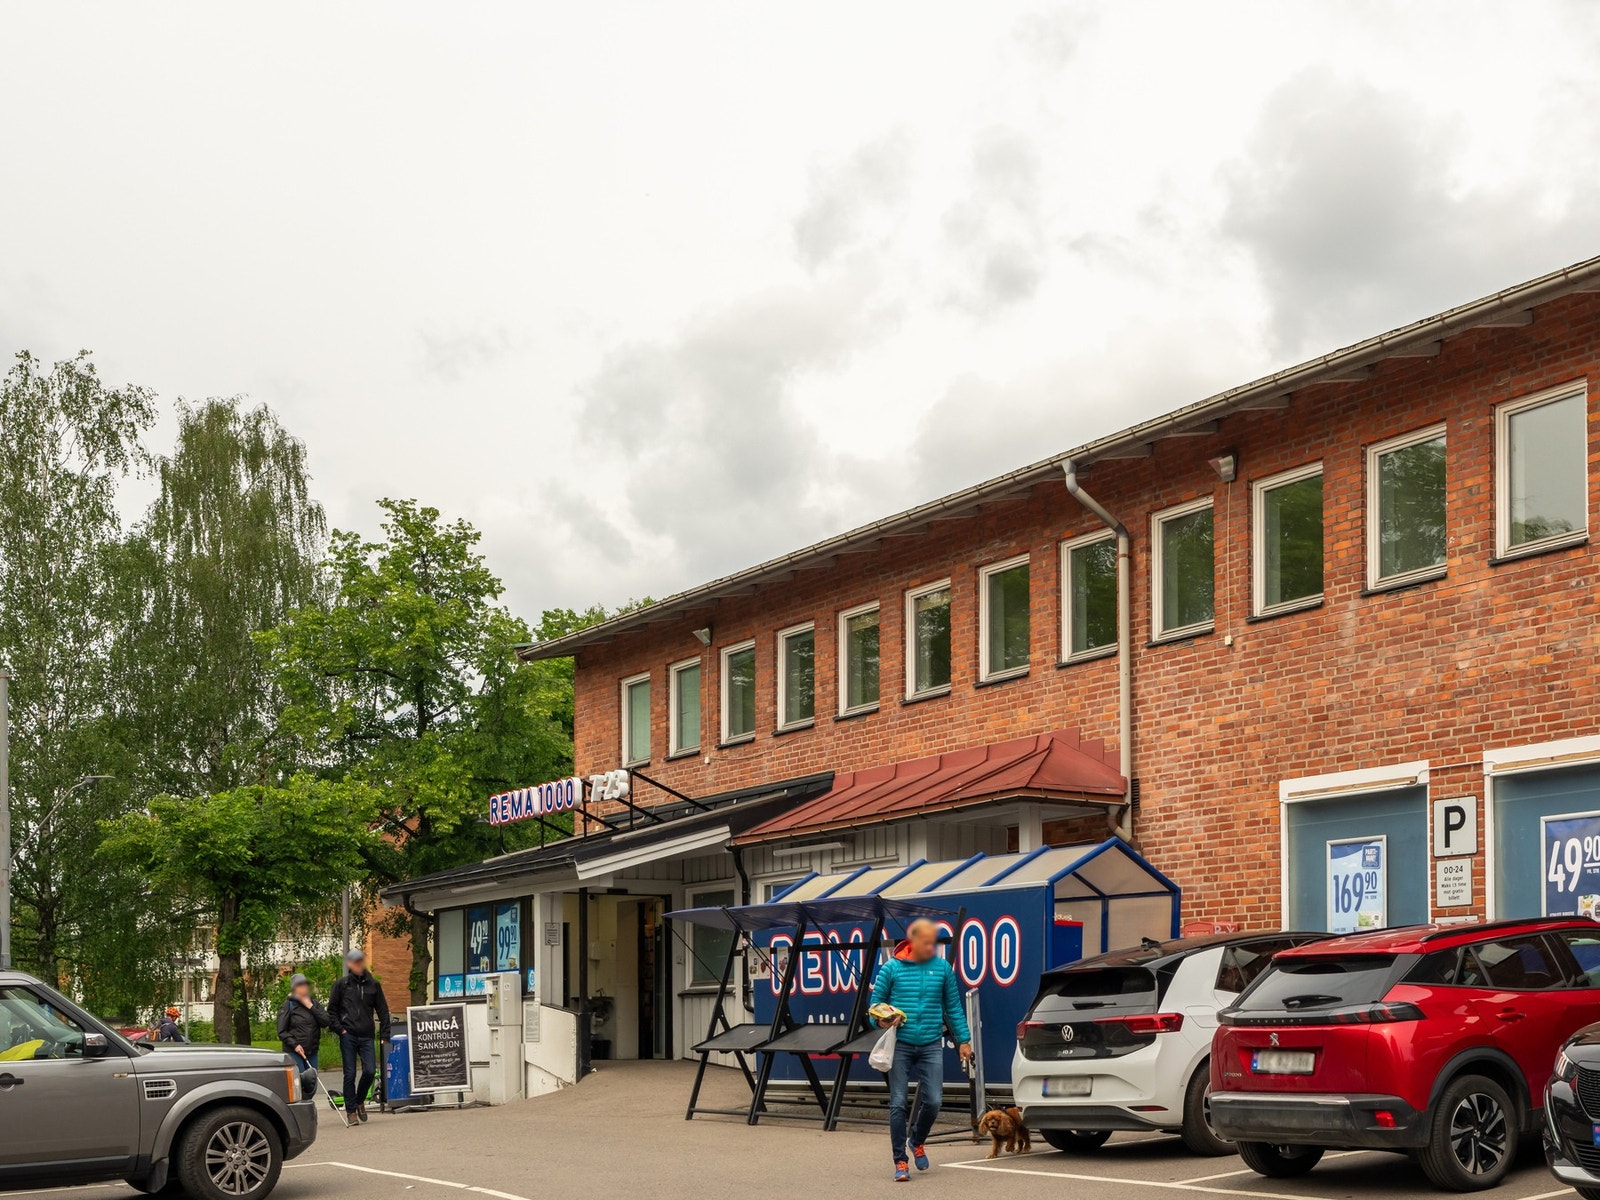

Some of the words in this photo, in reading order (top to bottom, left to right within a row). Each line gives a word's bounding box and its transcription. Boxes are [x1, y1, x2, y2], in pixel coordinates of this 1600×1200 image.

[489, 787, 535, 825] REMA
[537, 777, 577, 815] 1000
[589, 769, 628, 802] 7-23
[1444, 805, 1466, 848] P
[1444, 865, 1463, 874] 00-24
[1548, 837, 1583, 893] 49
[1583, 835, 1600, 862] 90
[1333, 872, 1364, 913] 169
[1365, 871, 1377, 890] 90
[470, 921, 483, 954] 49
[498, 926, 511, 960] 99
[511, 925, 517, 941] 90
[416, 1016, 459, 1033] UNNGÅ
[417, 1032, 459, 1041] KONTROLL-
[418, 1041, 460, 1050] SANKSJON
